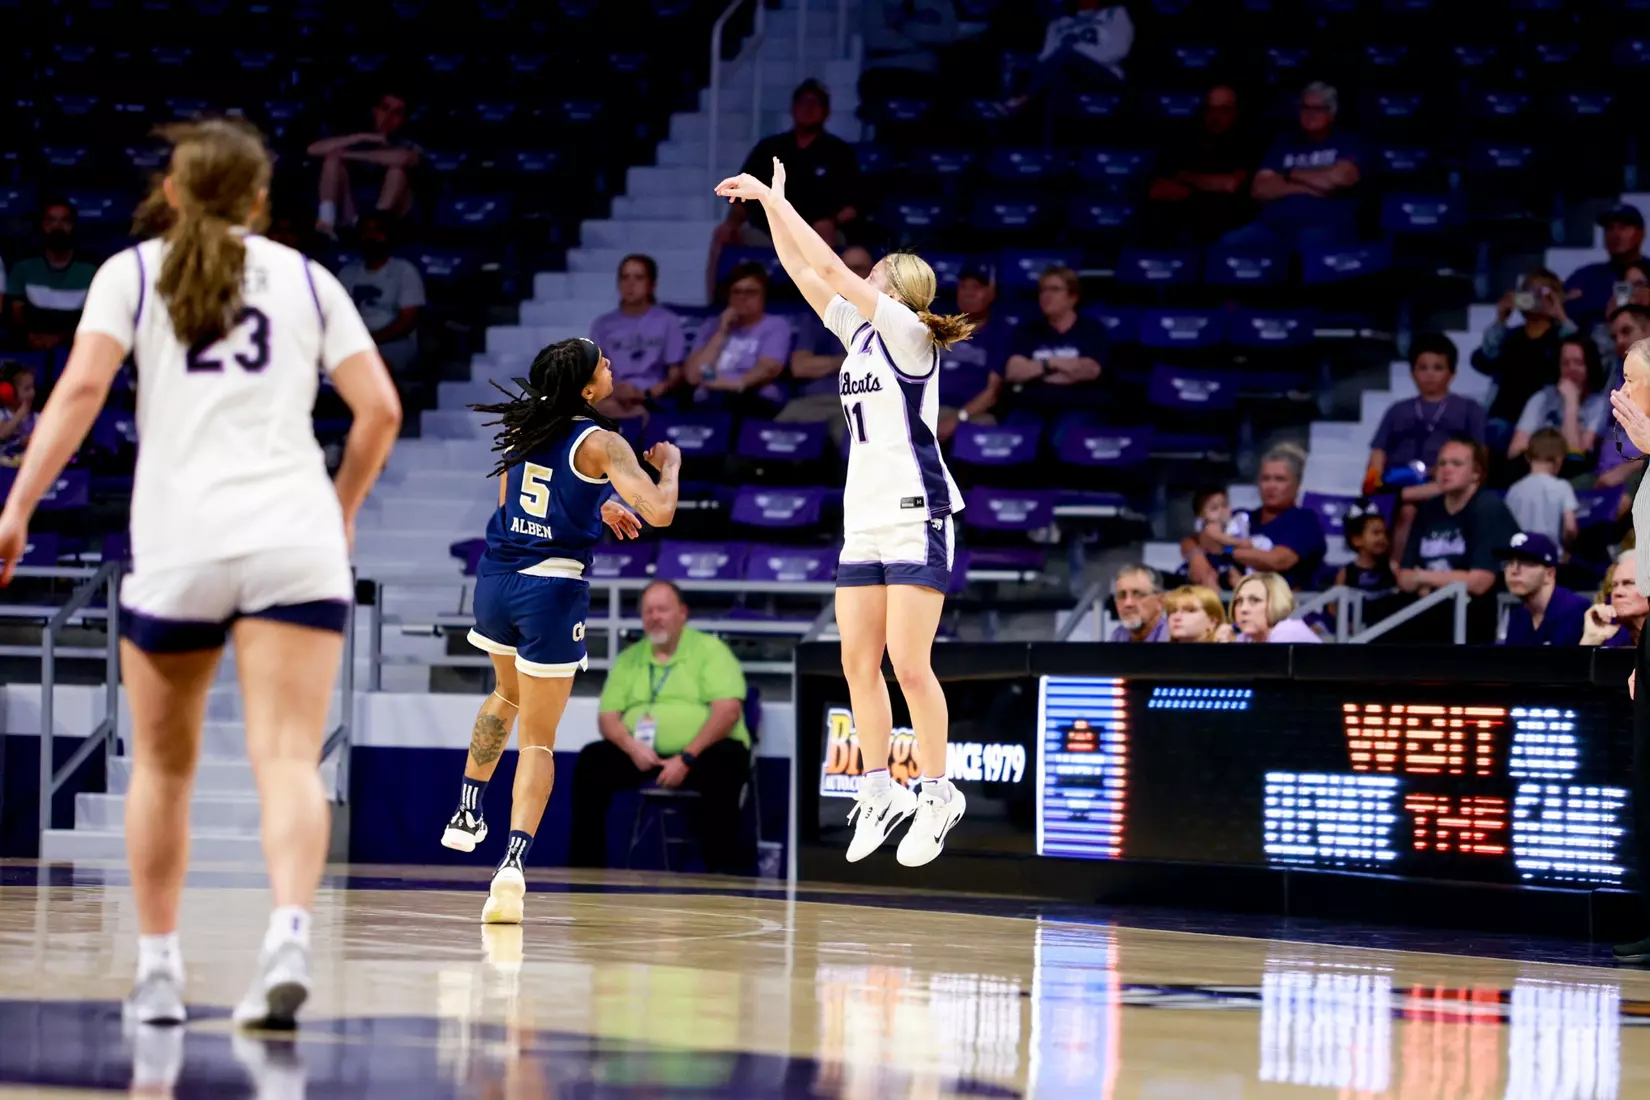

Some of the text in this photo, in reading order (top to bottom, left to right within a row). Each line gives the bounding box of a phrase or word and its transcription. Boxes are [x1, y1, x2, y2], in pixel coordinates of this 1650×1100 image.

[187, 307, 270, 373] 23
[519, 461, 553, 518] 5
[511, 517, 553, 539] ALBEN
[947, 742, 983, 781] NCE
[983, 743, 1026, 783] 1979
[1344, 703, 1506, 774] WBIT
[1405, 794, 1506, 854] THE
